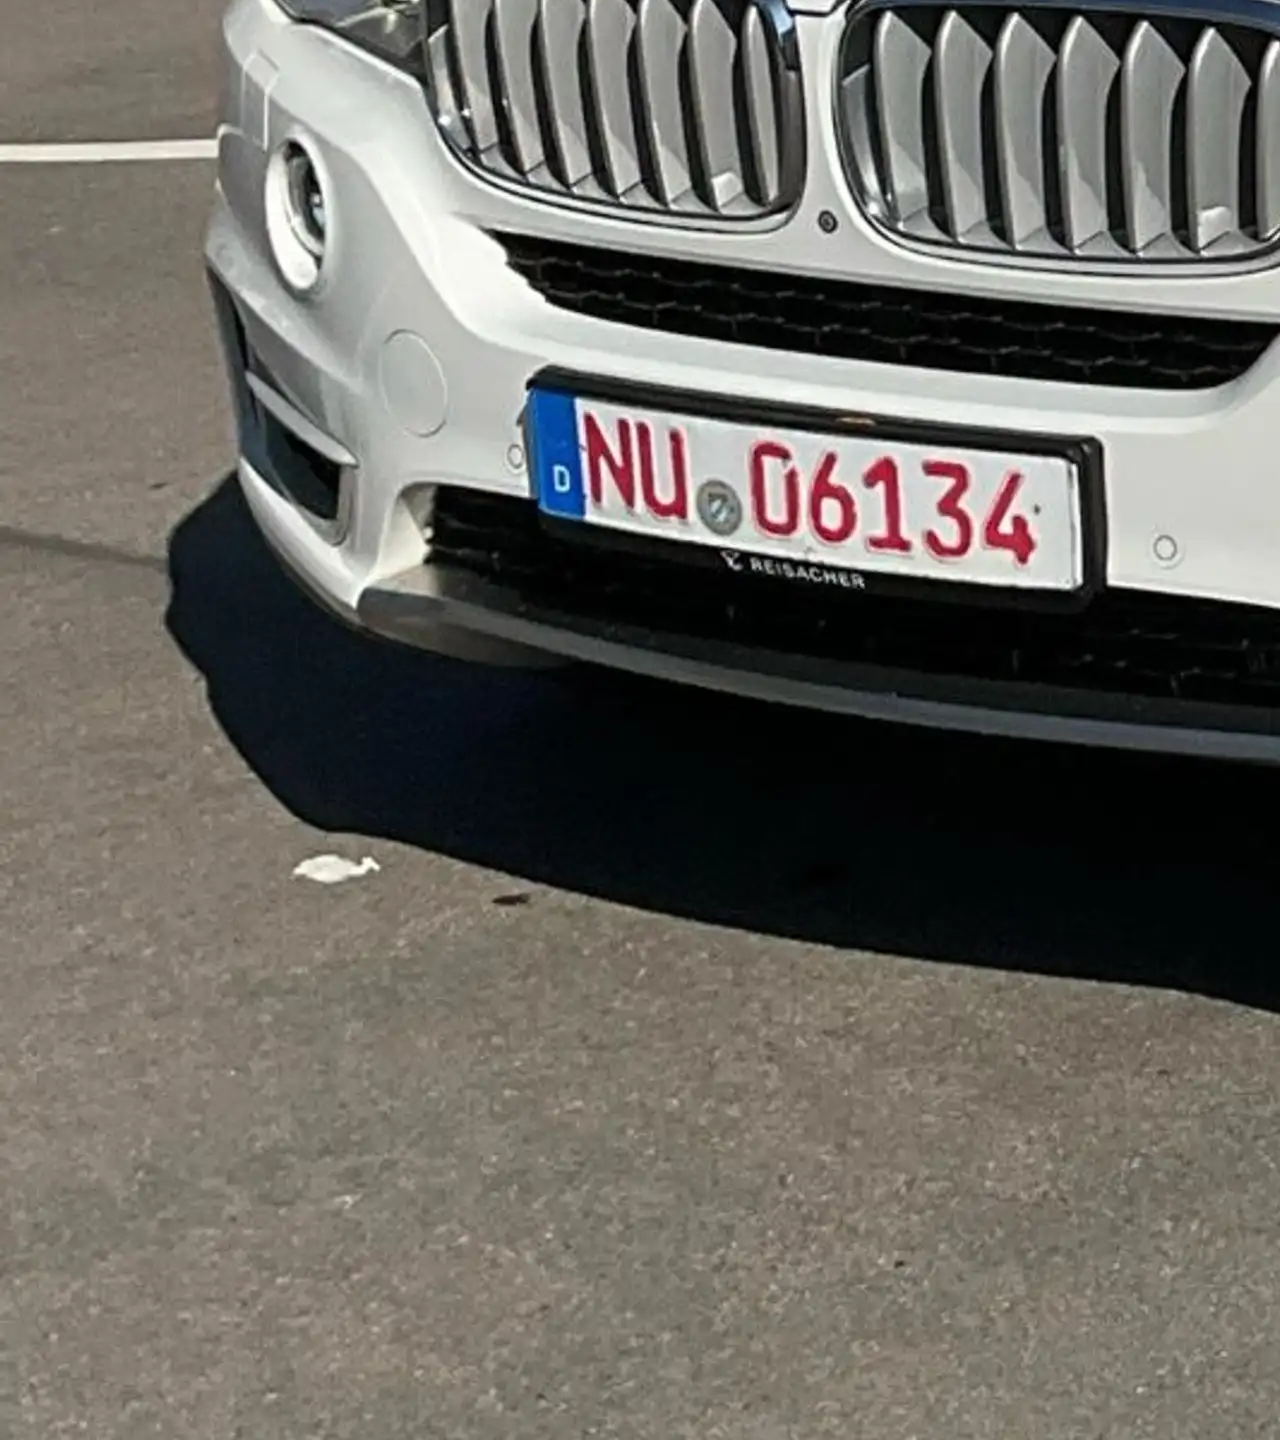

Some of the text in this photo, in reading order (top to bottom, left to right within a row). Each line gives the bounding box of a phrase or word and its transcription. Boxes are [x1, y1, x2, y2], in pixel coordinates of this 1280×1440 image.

[553, 412, 1036, 565] D NU 06134
[748, 556, 867, 591] REISACHER
